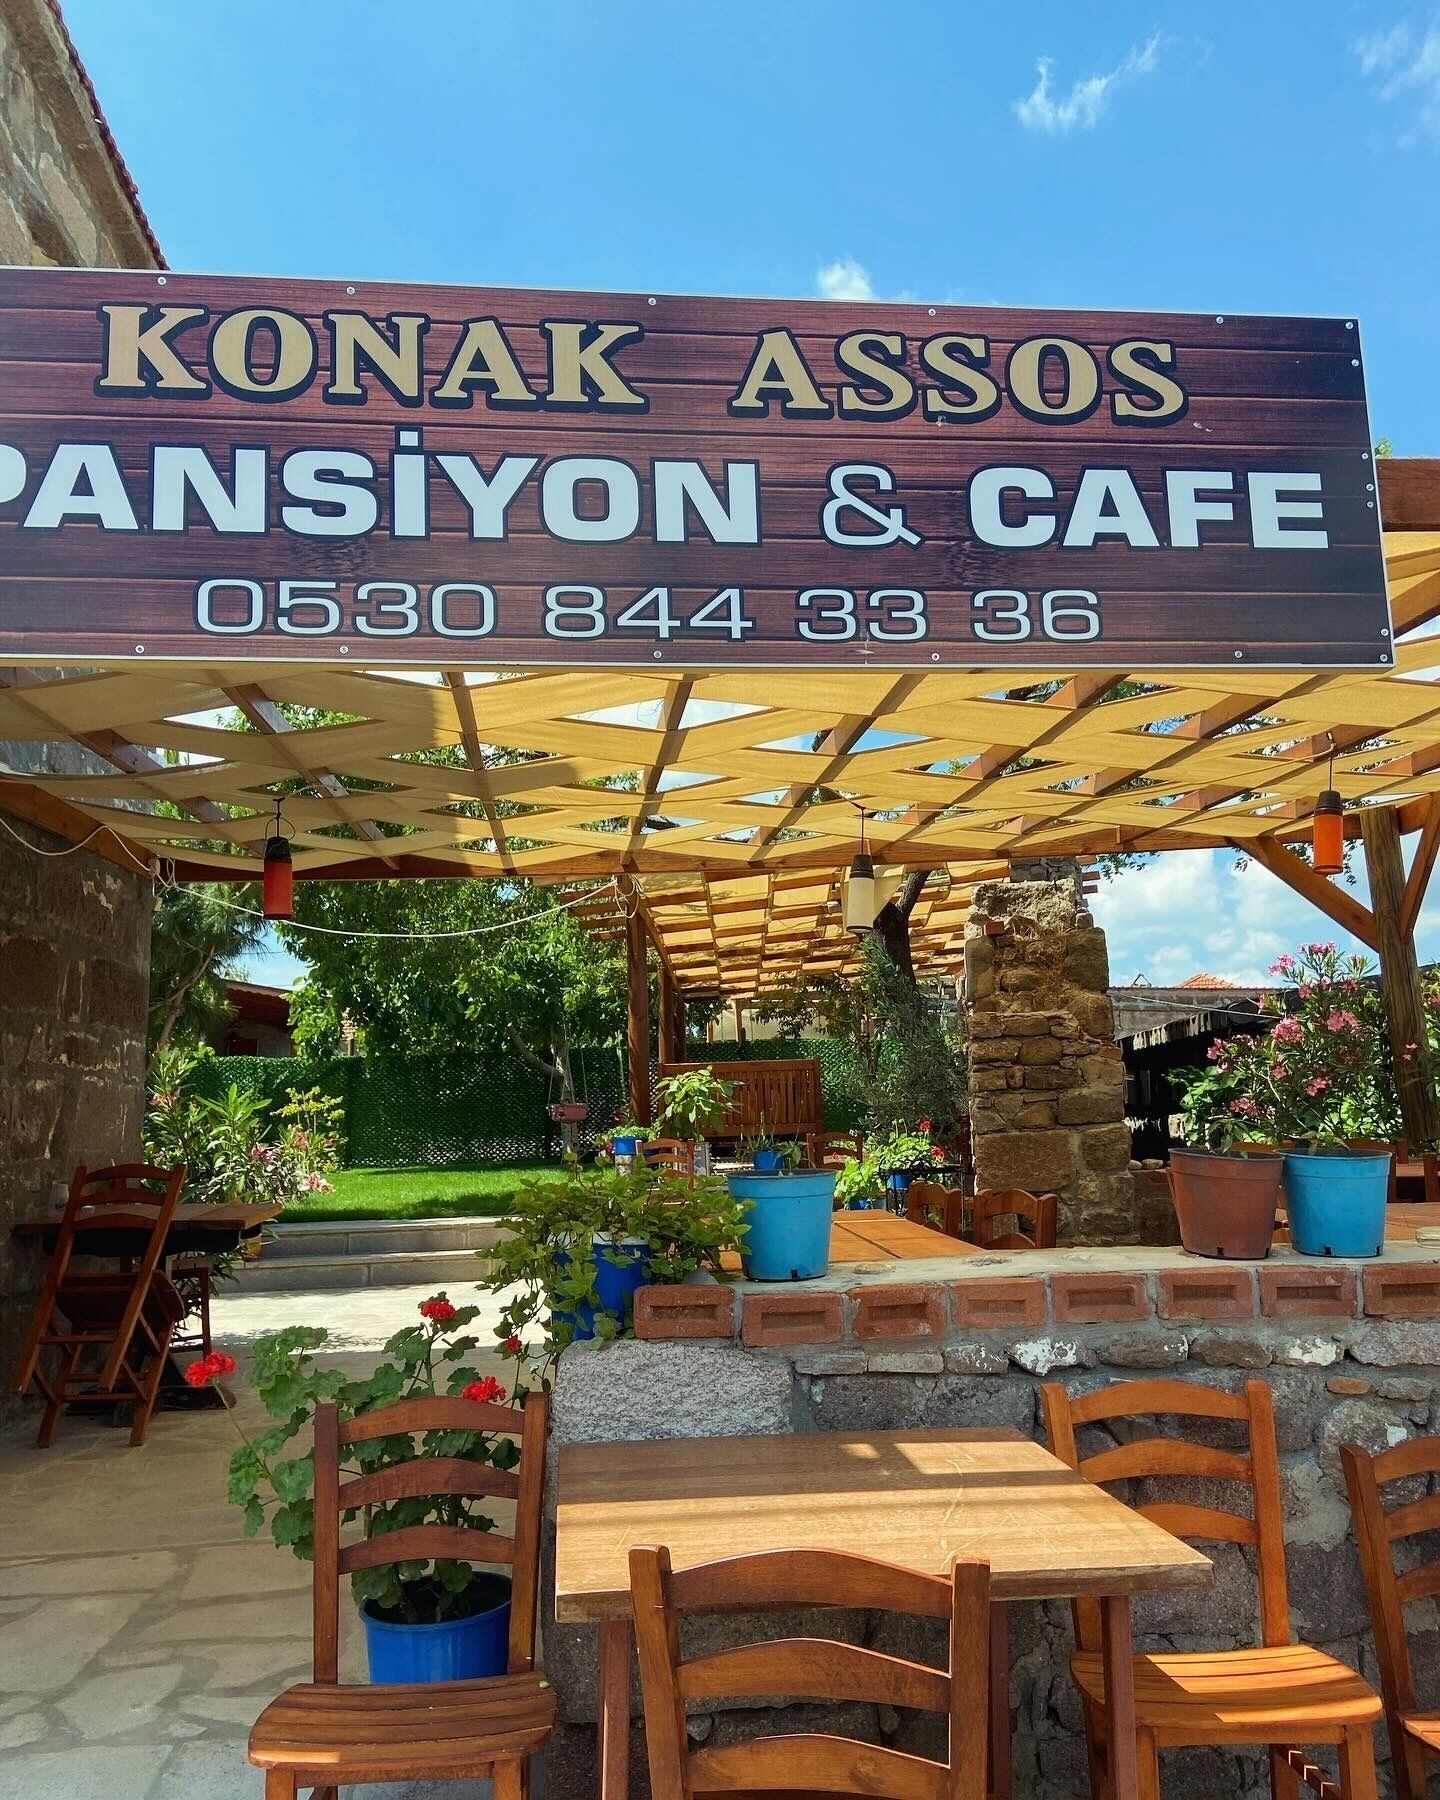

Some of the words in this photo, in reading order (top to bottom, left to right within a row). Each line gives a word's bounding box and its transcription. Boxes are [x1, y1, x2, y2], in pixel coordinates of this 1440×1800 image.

[99, 304, 645, 405] KONAK
[731, 329, 1184, 418] ASSOS
[0, 430, 759, 543] ANSİYON
[823, 465, 921, 546] &
[970, 467, 1328, 549] CAFE
[197, 578, 495, 637] 0530
[545, 586, 753, 641] 844
[798, 588, 927, 641] 33
[973, 589, 1100, 641] 36
